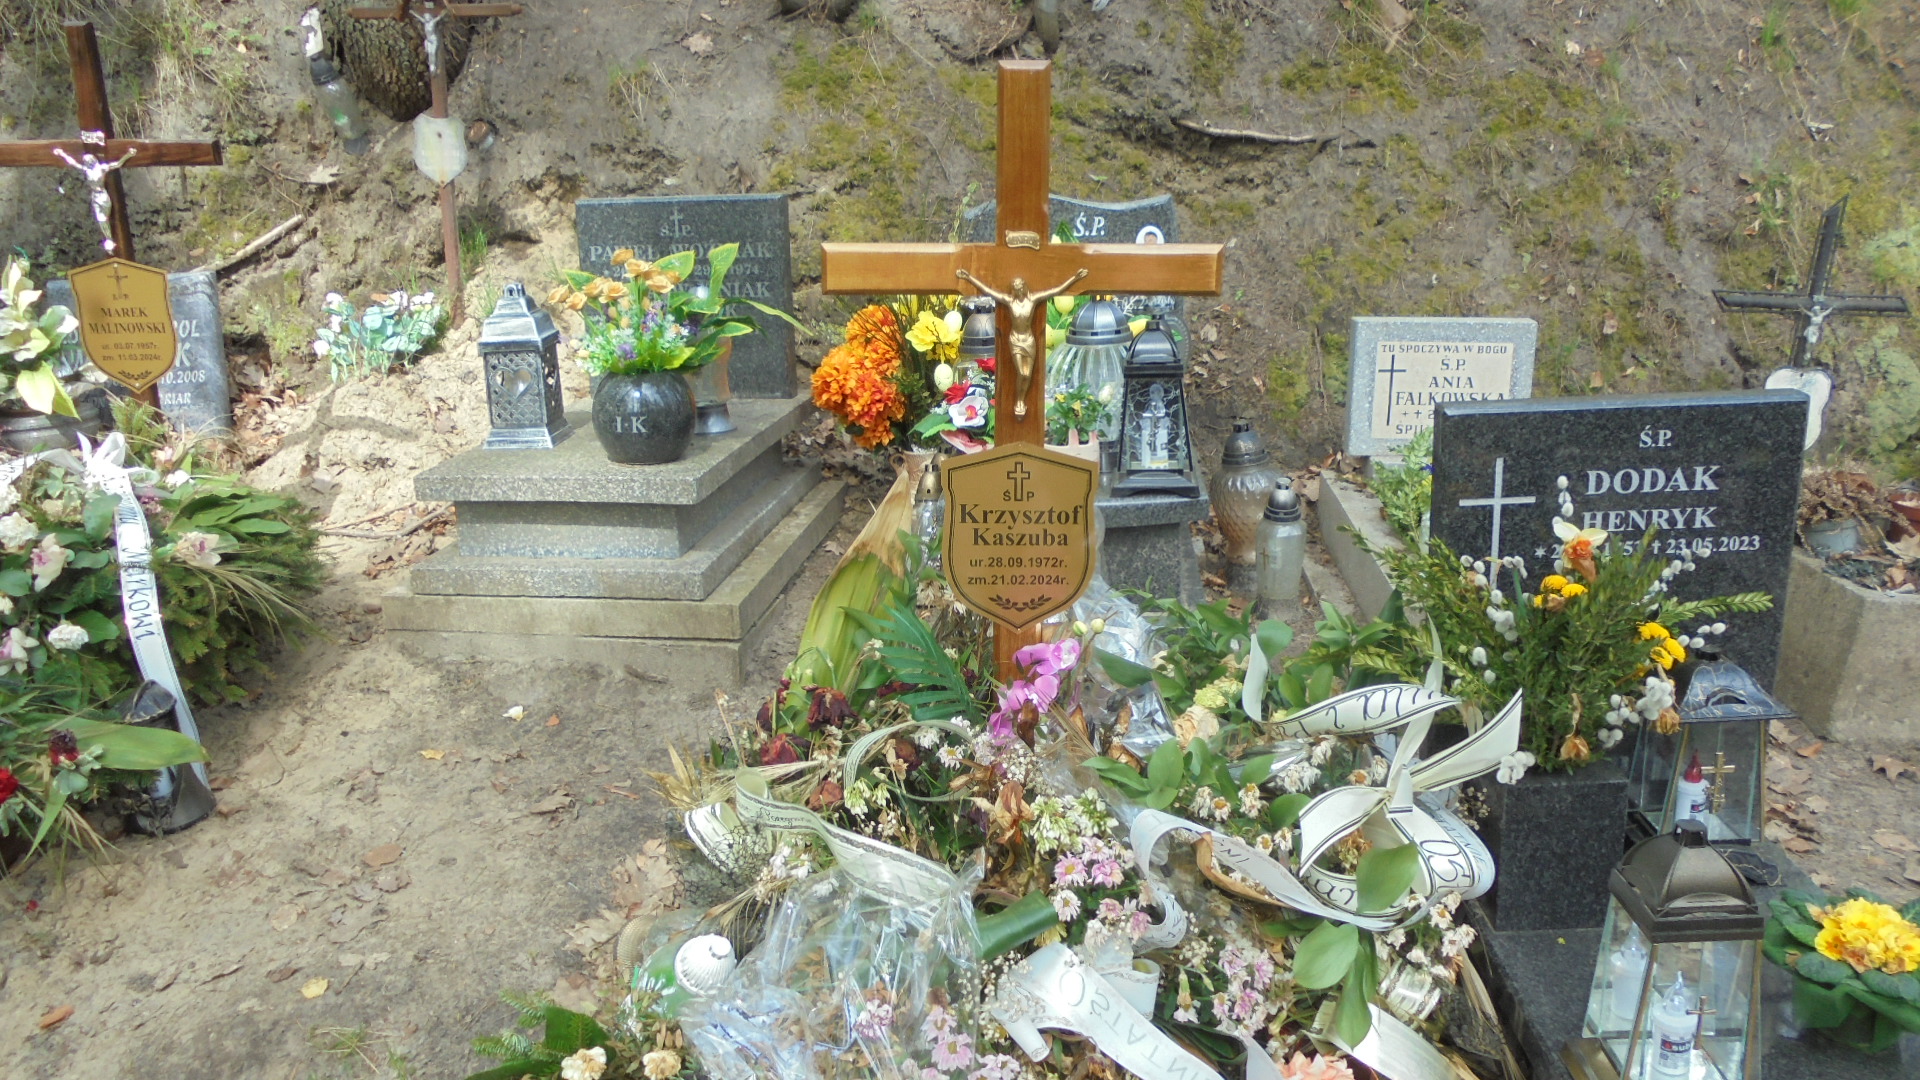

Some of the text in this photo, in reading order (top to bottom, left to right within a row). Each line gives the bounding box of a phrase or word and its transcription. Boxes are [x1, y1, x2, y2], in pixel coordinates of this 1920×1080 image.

[1073, 212, 1105, 237] Ś.P.
[100, 307, 149, 318] MAREK
[88, 322, 167, 335] MALINOWSKI
[1381, 344, 1508, 354] TU SPOCZYWA W BOGU
[1428, 376, 1474, 389] ANIA
[1639, 425, 1672, 449] Ś.P.
[1585, 465, 1722, 496] DODAK
[959, 504, 1083, 530] Krzysztof
[1582, 506, 1718, 532] HENRYK
[972, 528, 1069, 547] Kaszuba
[1665, 534, 1761, 555] 2305.2023
[969, 556, 1068, 568] ur.28.09.1972r.
[967, 574, 1070, 586] zm.21.02.2024r.
